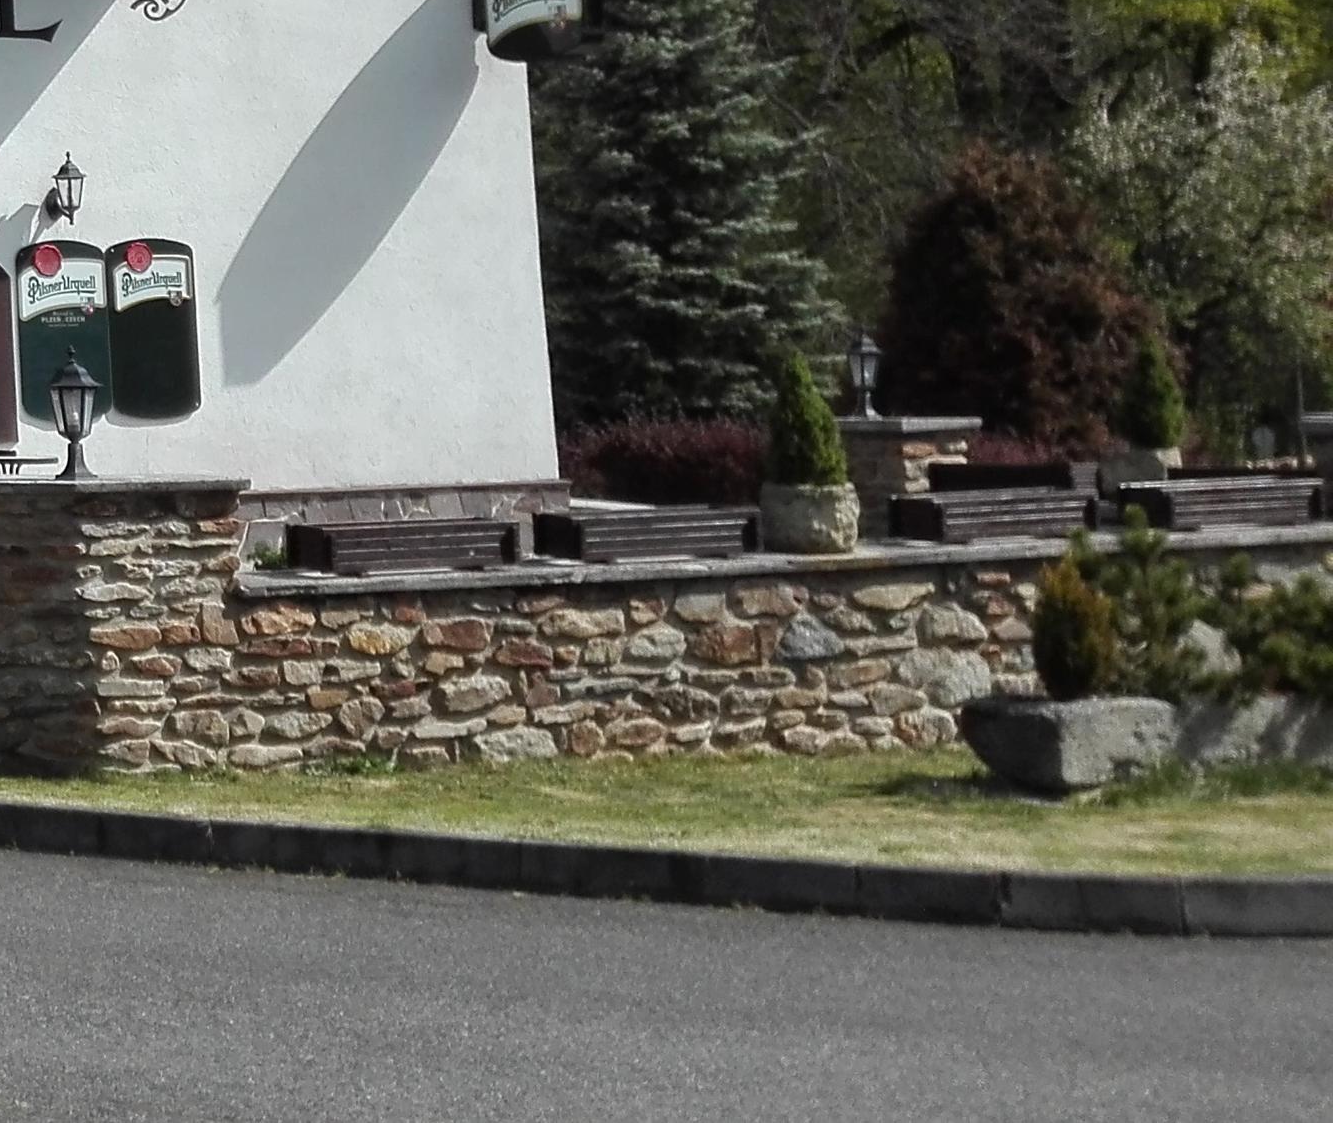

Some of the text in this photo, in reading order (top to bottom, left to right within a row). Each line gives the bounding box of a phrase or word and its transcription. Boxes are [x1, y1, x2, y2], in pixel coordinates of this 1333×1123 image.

[28, 275, 96, 304] Pilsner Urquell
[121, 271, 183, 297] Pilsner Urquell
